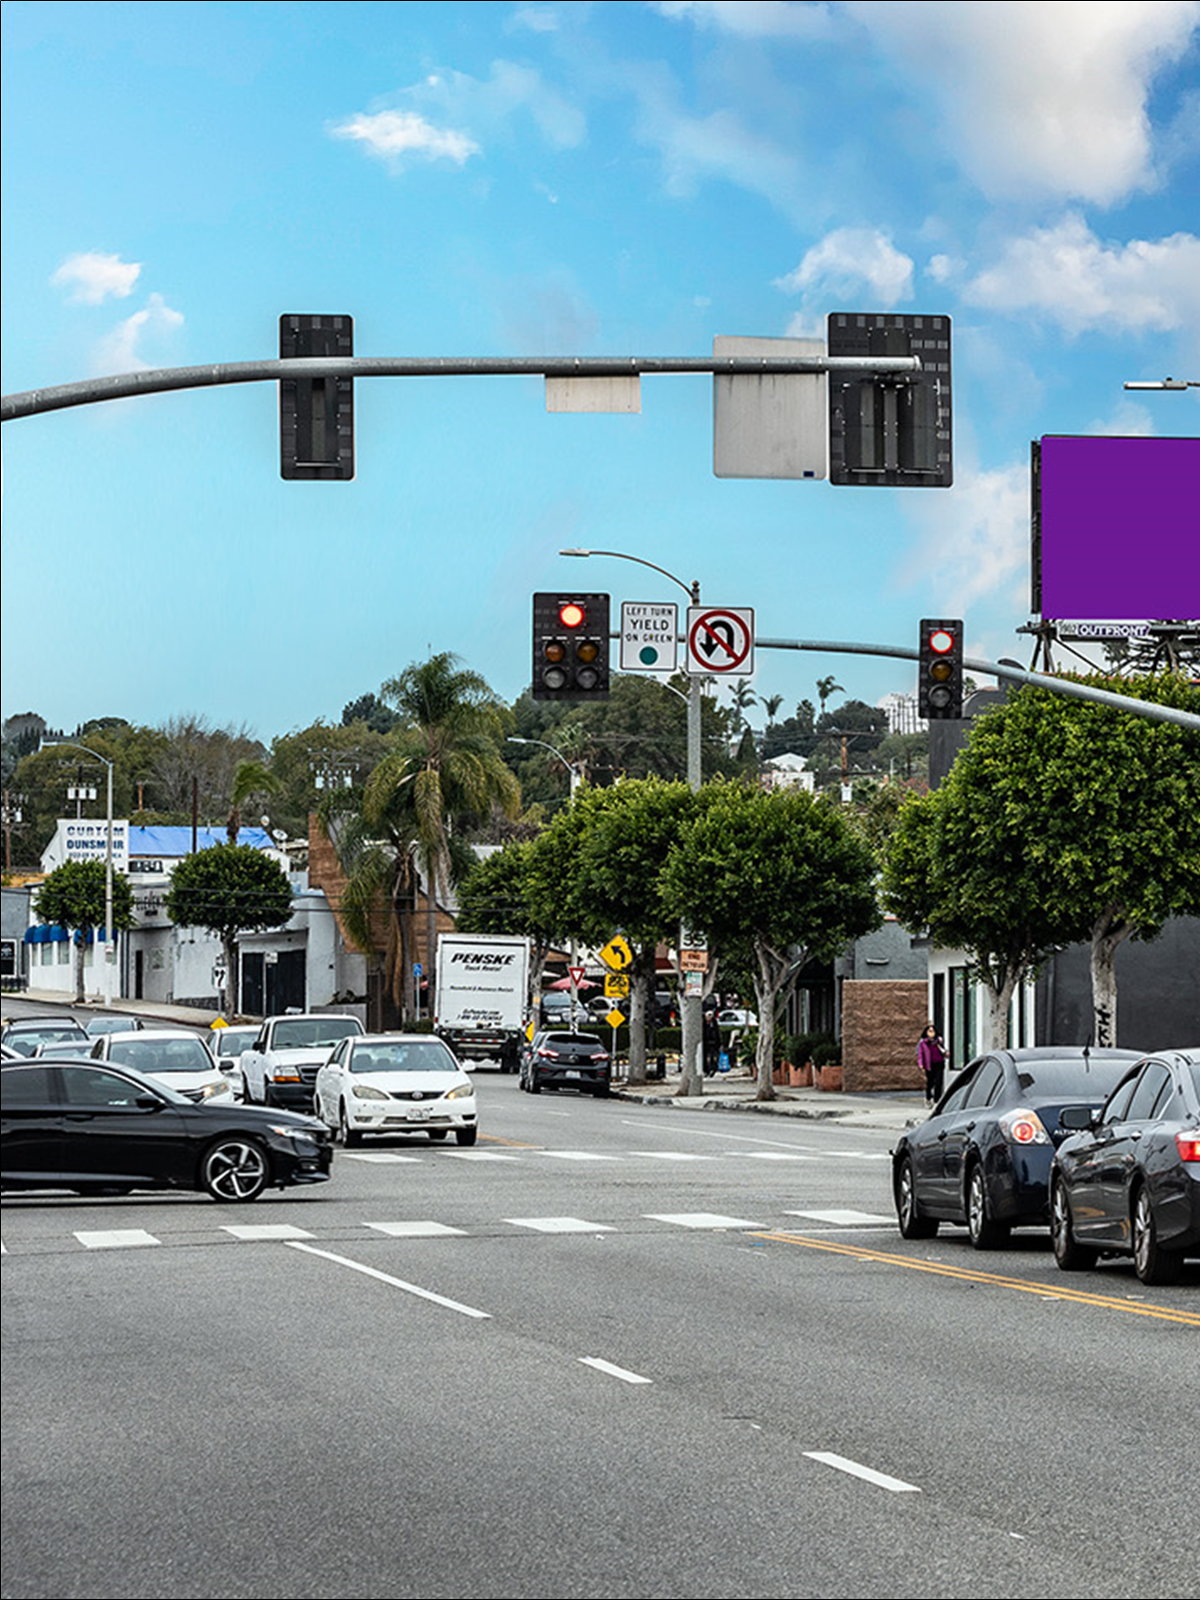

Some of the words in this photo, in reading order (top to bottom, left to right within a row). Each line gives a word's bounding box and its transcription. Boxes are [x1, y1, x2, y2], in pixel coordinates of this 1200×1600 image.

[626, 607, 647, 616] LEFT
[650, 607, 673, 616] TURN
[630, 619, 670, 631] YIELD
[1080, 624, 1148, 636] OUTFRONT
[625, 633, 639, 642] ON
[643, 633, 673, 643] GREEN
[67, 840, 124, 849] DUNSMIR
[451, 953, 516, 966] PENSKE
